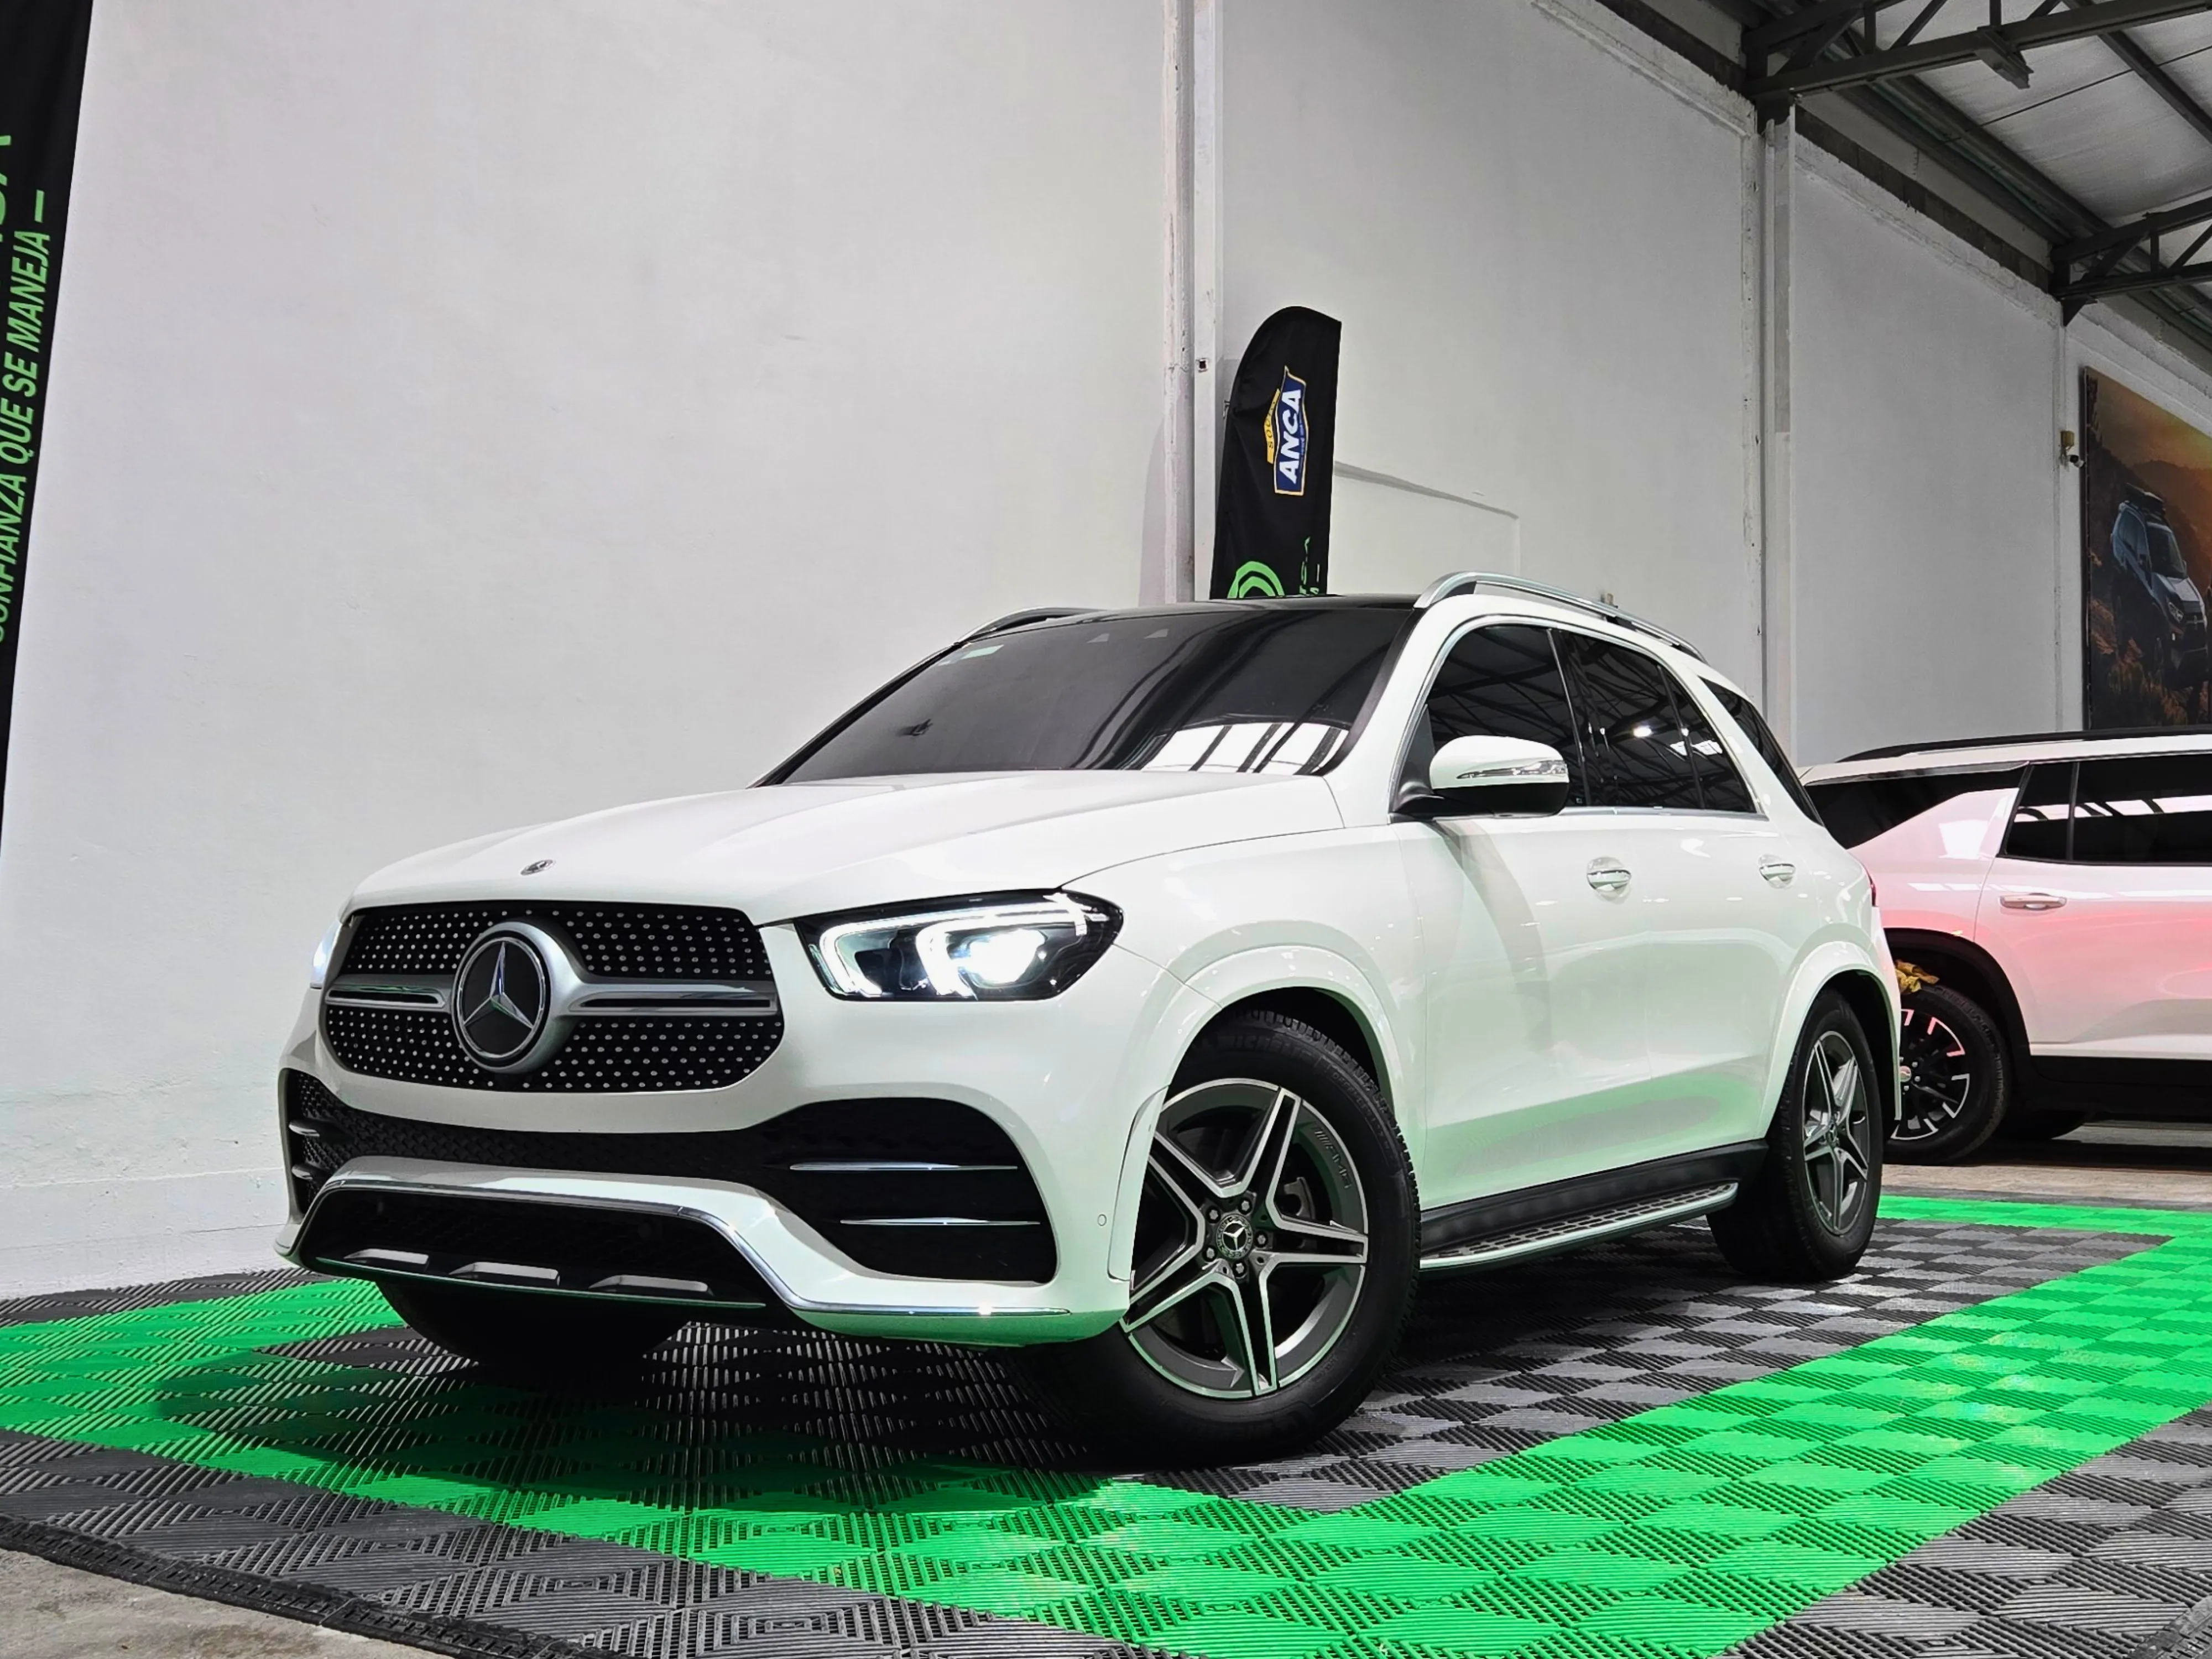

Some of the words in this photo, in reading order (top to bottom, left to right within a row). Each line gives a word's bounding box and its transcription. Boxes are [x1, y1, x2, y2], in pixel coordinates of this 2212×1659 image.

[6, 231, 50, 353] MANEJA
[2, 352, 38, 398] SE
[0, 397, 34, 465] QUE
[1279, 389, 1302, 484] ANCA
